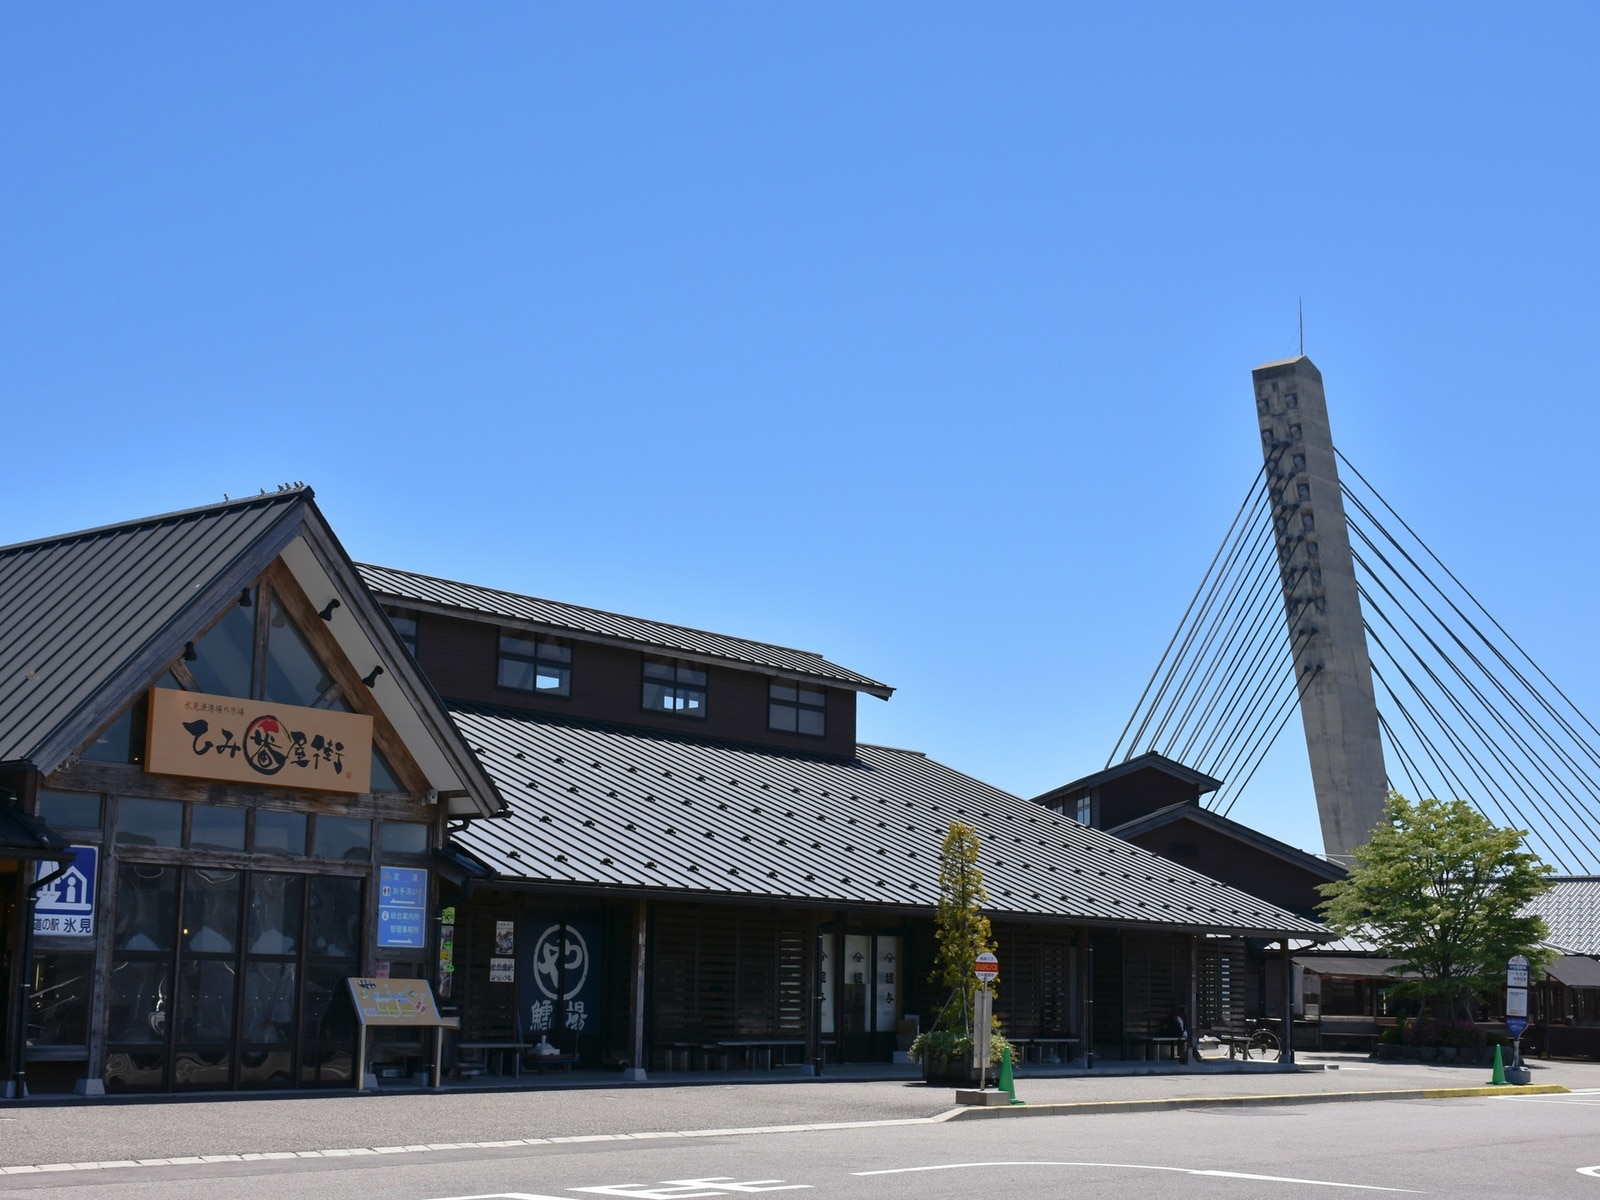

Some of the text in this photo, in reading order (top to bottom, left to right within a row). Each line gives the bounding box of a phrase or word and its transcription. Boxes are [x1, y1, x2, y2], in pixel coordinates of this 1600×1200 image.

[183, 716, 345, 775] ひみ番屋街
[33, 917, 92, 933] 道の駅 氷見
